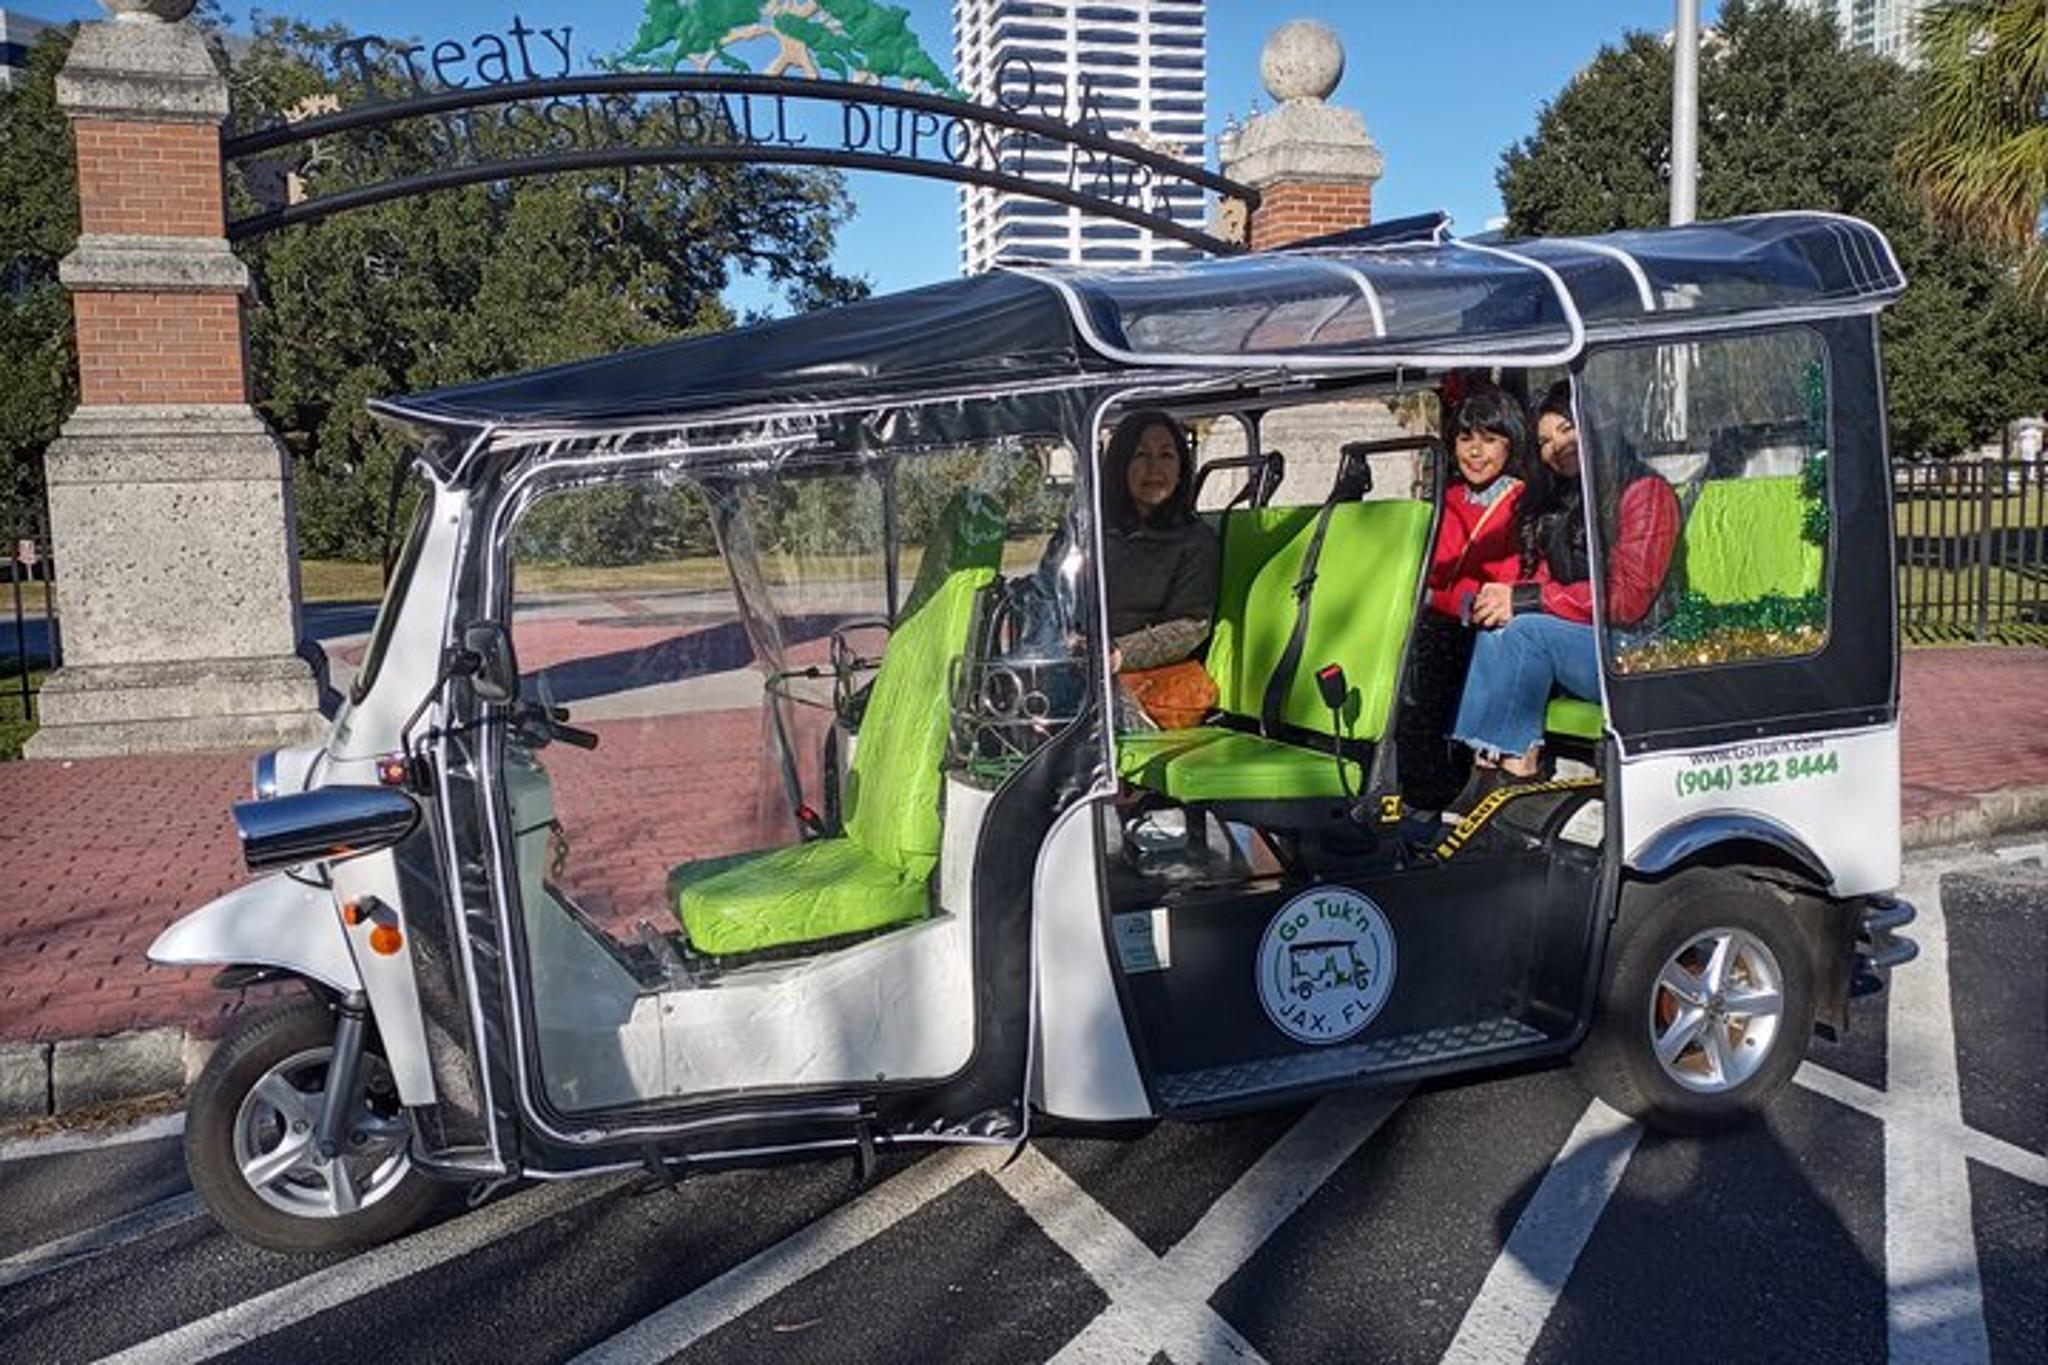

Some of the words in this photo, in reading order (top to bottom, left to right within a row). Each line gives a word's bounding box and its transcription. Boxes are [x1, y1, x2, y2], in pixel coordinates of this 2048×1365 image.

[327, 14, 573, 104] Treaty
[996, 58, 1114, 140] Oak
[668, 93, 807, 147] BALL
[841, 101, 1041, 179] DUPONT
[1675, 765, 1734, 797] (904)
[1739, 759, 1779, 786] 322
[1786, 750, 1838, 779] 8444
[1279, 913, 1310, 942] Go
[1313, 899, 1370, 934] Tuk'n
[1342, 999, 1372, 1025] FL
